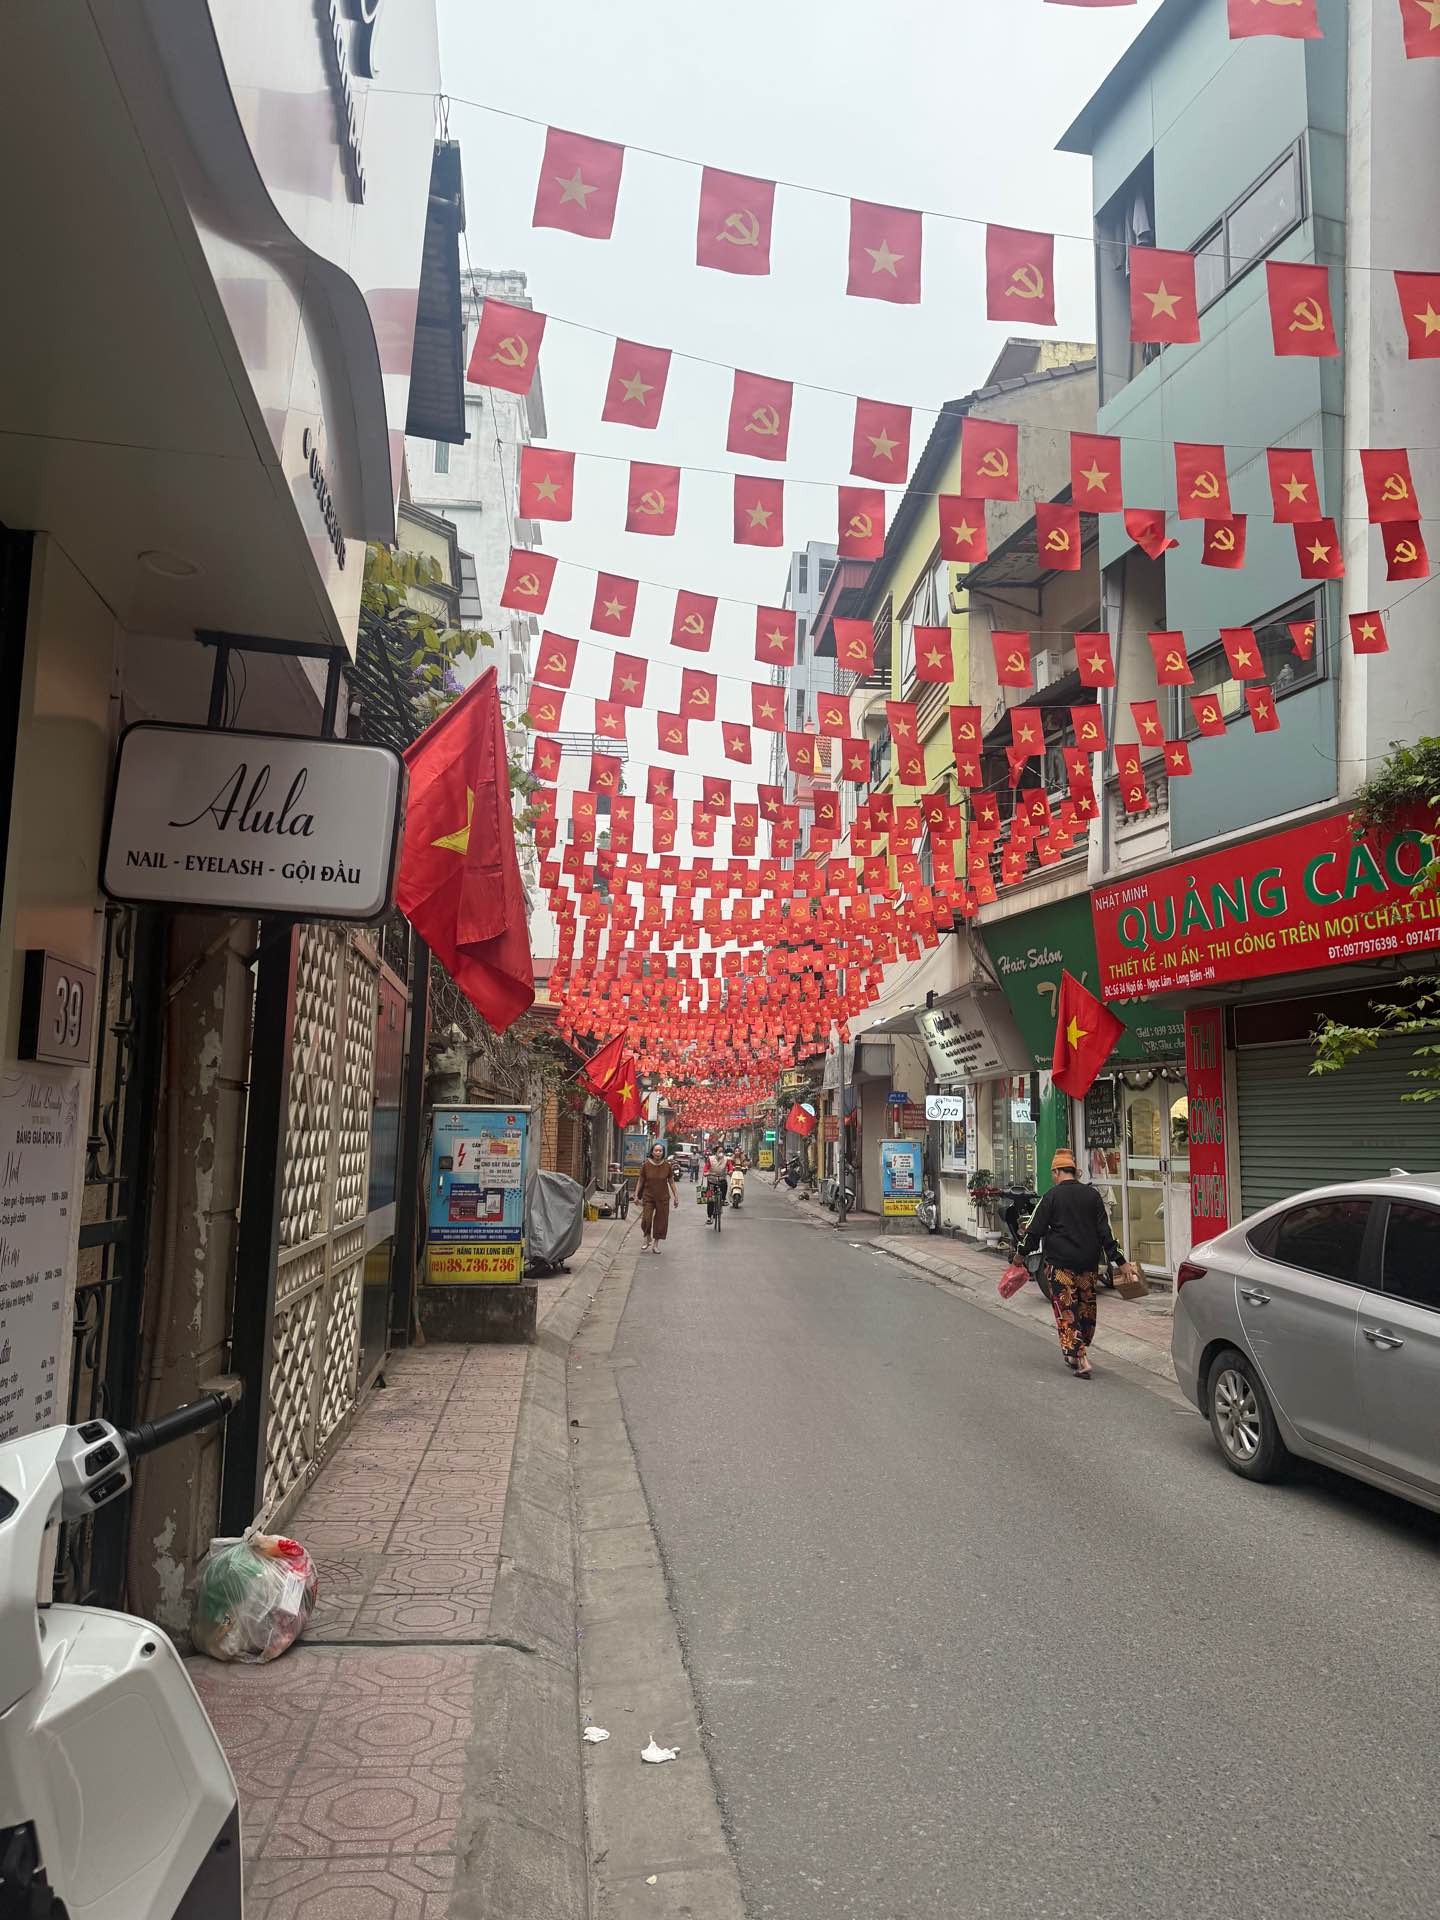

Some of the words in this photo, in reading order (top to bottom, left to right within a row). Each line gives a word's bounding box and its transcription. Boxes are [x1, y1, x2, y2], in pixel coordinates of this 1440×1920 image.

[168, 763, 314, 836] Alula
[126, 851, 168, 869] NAIL
[185, 855, 264, 876] EYELASH
[281, 859, 316, 884] GỘI
[320, 860, 361, 884] ĐẦU
[1095, 892, 1119, 911] NHẬT
[1122, 884, 1149, 903] MINH
[1117, 867, 1288, 953] QUẢNG
[998, 955, 1027, 975] Hair
[1027, 946, 1063, 968] Salon
[1109, 956, 1139, 979] THIẾT
[1142, 952, 1157, 973] KẾ
[1208, 942, 1231, 960] THI
[1234, 932, 1277, 955] CÔNG
[1279, 920, 1321, 946] TRÊN
[1325, 914, 1360, 939] MỌI
[1136, 980, 1144, 991] 66
[1147, 977, 1160, 991] Ngọc
[1160, 974, 1172, 987] Lâm
[1175, 972, 1190, 986] Long
[1189, 968, 1203, 981] Biên
[54, 975, 84, 1048] 39
[1191, 1024, 1217, 1070] THI
[927, 1096, 959, 1120] Spa
[1190, 1084, 1224, 1145] CÔNG
[32, 1127, 42, 1144] GIÁ
[42, 1130, 55, 1148] DỊCH
[472, 1247, 486, 1255] TAXI
[486, 1247, 501, 1255] LONG
[501, 1246, 515, 1255] BIÊN
